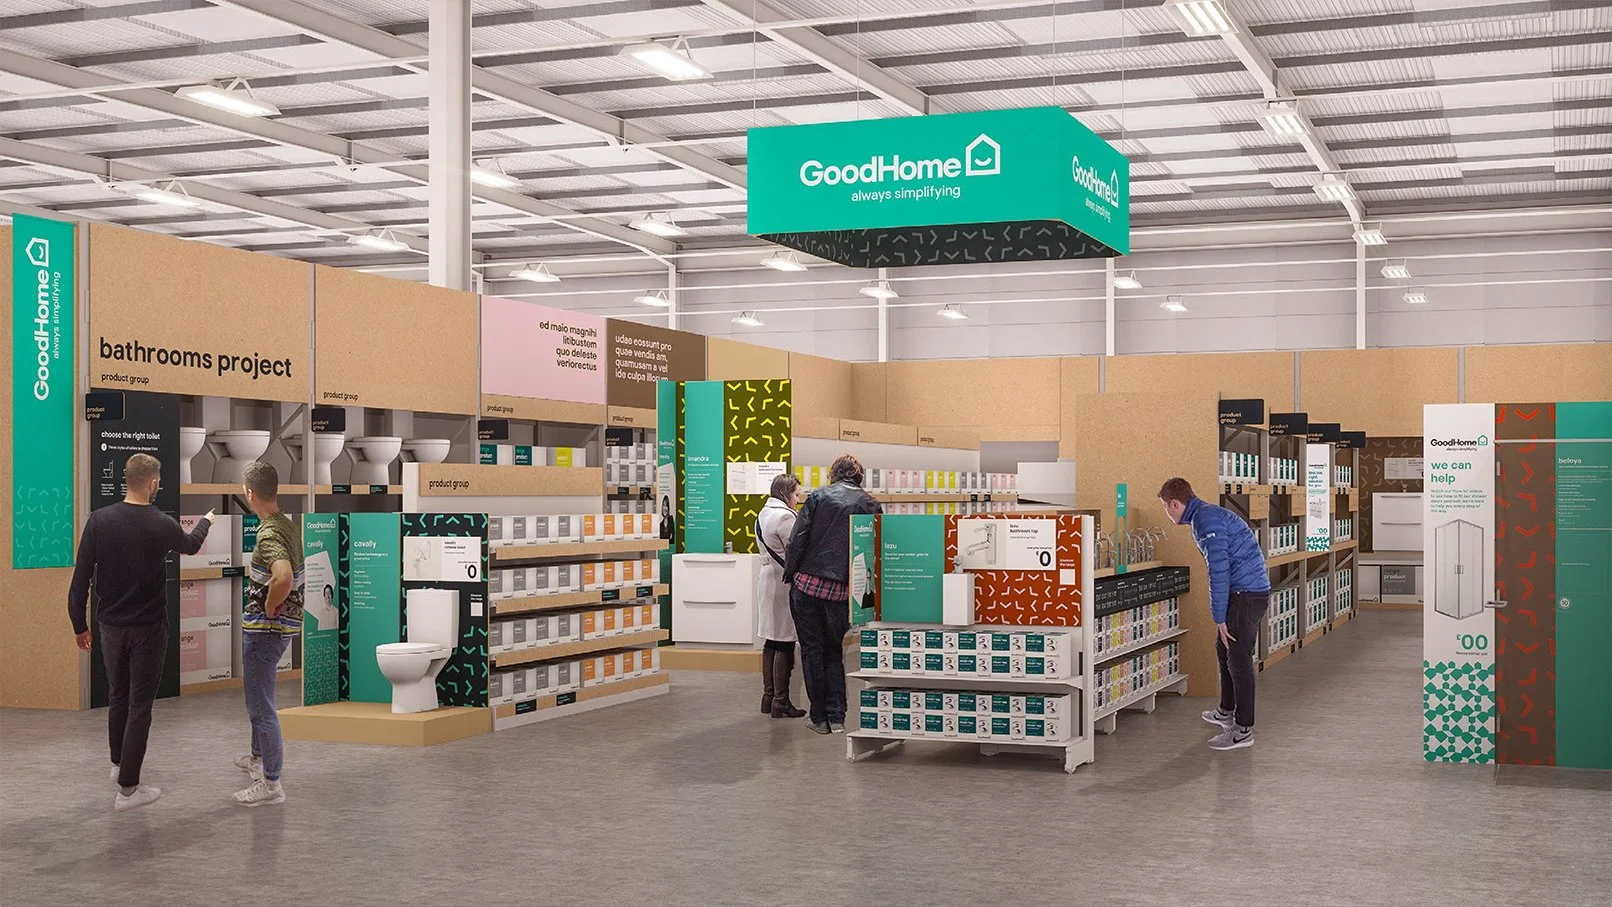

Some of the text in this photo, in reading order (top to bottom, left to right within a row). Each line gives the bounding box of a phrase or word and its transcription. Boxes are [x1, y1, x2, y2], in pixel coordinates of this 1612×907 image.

[800, 154, 962, 187] GoodHome
[1072, 155, 1110, 204] GoodHome
[851, 184, 960, 202] always simplifying
[53, 272, 61, 324] simplifying
[34, 270, 50, 401] GoodHome
[540, 320, 597, 338] ed maio magnihi
[562, 336, 597, 349] litibustem
[661, 343, 672, 352] pro
[100, 336, 292, 380] bathrooms project
[556, 348, 597, 360] quo deleste
[615, 346, 668, 362] quae vendis am,
[556, 360, 597, 372] veriorectus
[615, 358, 652, 371] quamusam
[658, 363, 668, 373] vel
[102, 372, 150, 385] product group
[615, 368, 626, 379] ide
[627, 370, 646, 382] culpa
[324, 390, 358, 402] product group
[487, 405, 502, 413] product
[132, 432, 145, 440] right
[429, 478, 469, 490] product group
[1431, 474, 1456, 485] help
[354, 541, 377, 549] cavally
[1456, 634, 1488, 650] £00
